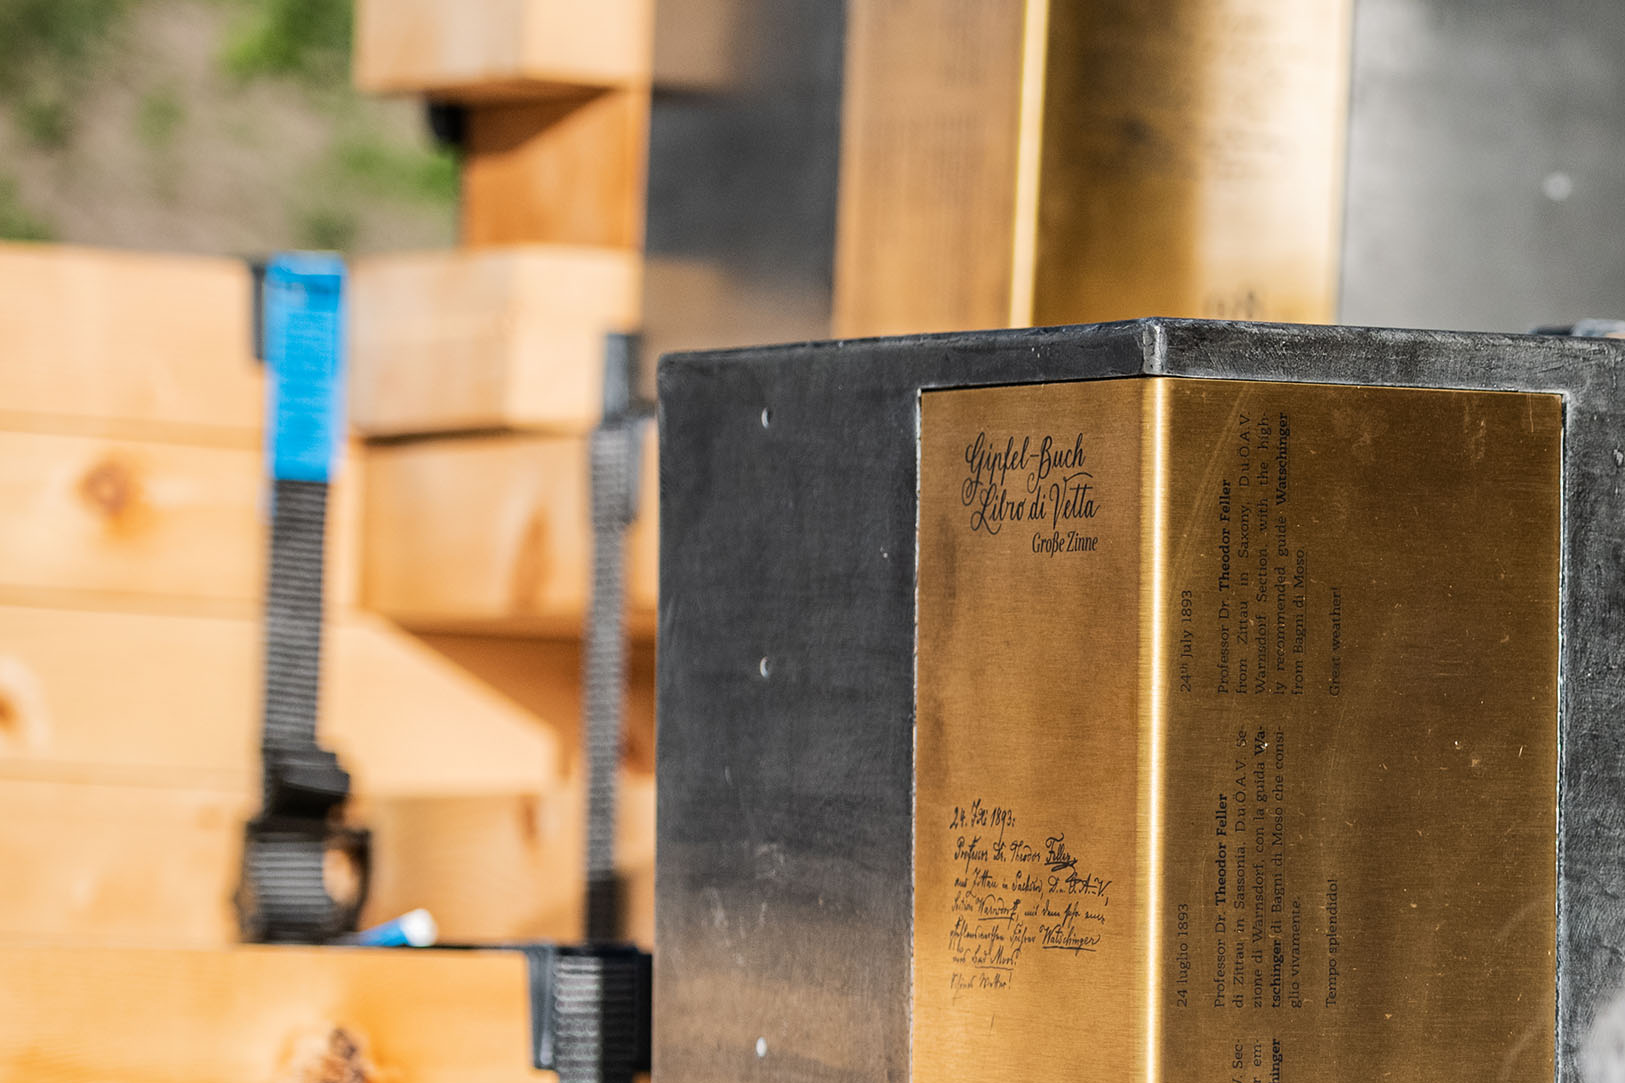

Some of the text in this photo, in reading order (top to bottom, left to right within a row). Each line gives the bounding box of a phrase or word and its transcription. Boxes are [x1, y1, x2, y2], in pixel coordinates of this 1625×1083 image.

[962, 432, 1086, 506] Gipfel-Buch
[1258, 462, 1268, 486] the
[1275, 412, 1290, 506] Watschinger
[970, 472, 1100, 535] Libro di Vetta
[1219, 478, 1232, 522] Feller
[1256, 498, 1268, 532] with
[1032, 531, 1098, 558] Große Zinne
[1218, 528, 1231, 592] Theodor
[1238, 572, 1248, 587] in
[1180, 590, 1192, 623] 1893
[1237, 600, 1248, 645] Zittau
[1274, 566, 1286, 672] recommended
[1180, 629, 1194, 659] July
[1217, 624, 1230, 694] Professor
[1328, 586, 1342, 697] Great weather!
[1236, 658, 1248, 694] from
[1274, 680, 1288, 695] ly
[1292, 660, 1304, 696] from
[1253, 762, 1268, 802] guida
[1272, 776, 1284, 802] che
[1252, 808, 1266, 821] la
[1272, 807, 1284, 846] Moso
[1254, 827, 1265, 854] con
[1272, 851, 1283, 866] di
[1214, 793, 1228, 1008] Professor Dr. Theodor Feller
[1271, 872, 1286, 913] Bagni
[1234, 918, 1245, 933] in
[1271, 920, 1282, 934] di
[1324, 878, 1340, 1008] Tempo splendido!
[1176, 903, 1192, 1008] 24 luglio 1893
[1251, 949, 1263, 964] di
[1270, 939, 1284, 1008] tschinger
[1232, 994, 1244, 1008] di
[1252, 969, 1262, 1008] zione
[1288, 981, 1304, 1008] glio
